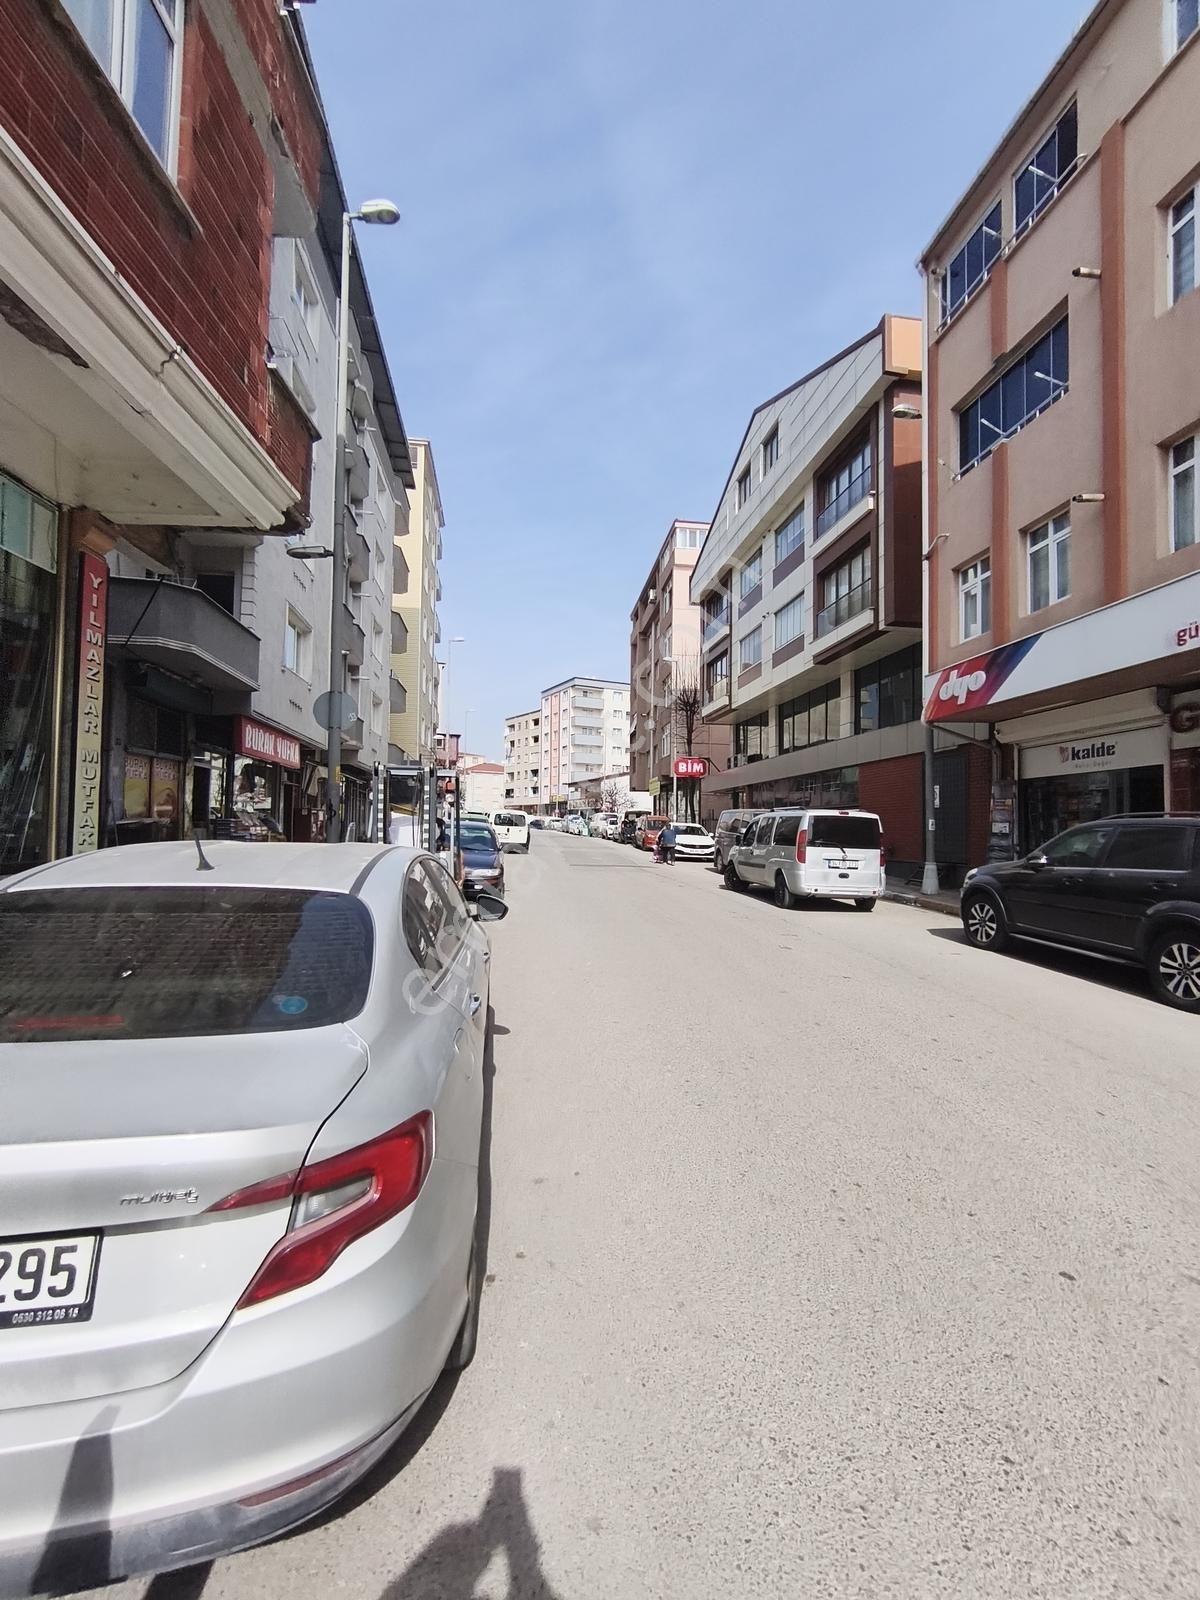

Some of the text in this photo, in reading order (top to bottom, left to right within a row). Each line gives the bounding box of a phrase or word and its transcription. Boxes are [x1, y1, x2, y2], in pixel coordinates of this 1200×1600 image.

[1176, 620, 1200, 647] gü
[939, 669, 987, 705] dyo
[78, 571, 104, 846] YILMAZLAR MUTFAK
[245, 724, 300, 763] BURAK YUFKA
[1071, 742, 1116, 761] kalde
[678, 759, 704, 773] BİM
[35, 1309, 53, 1321] 312
